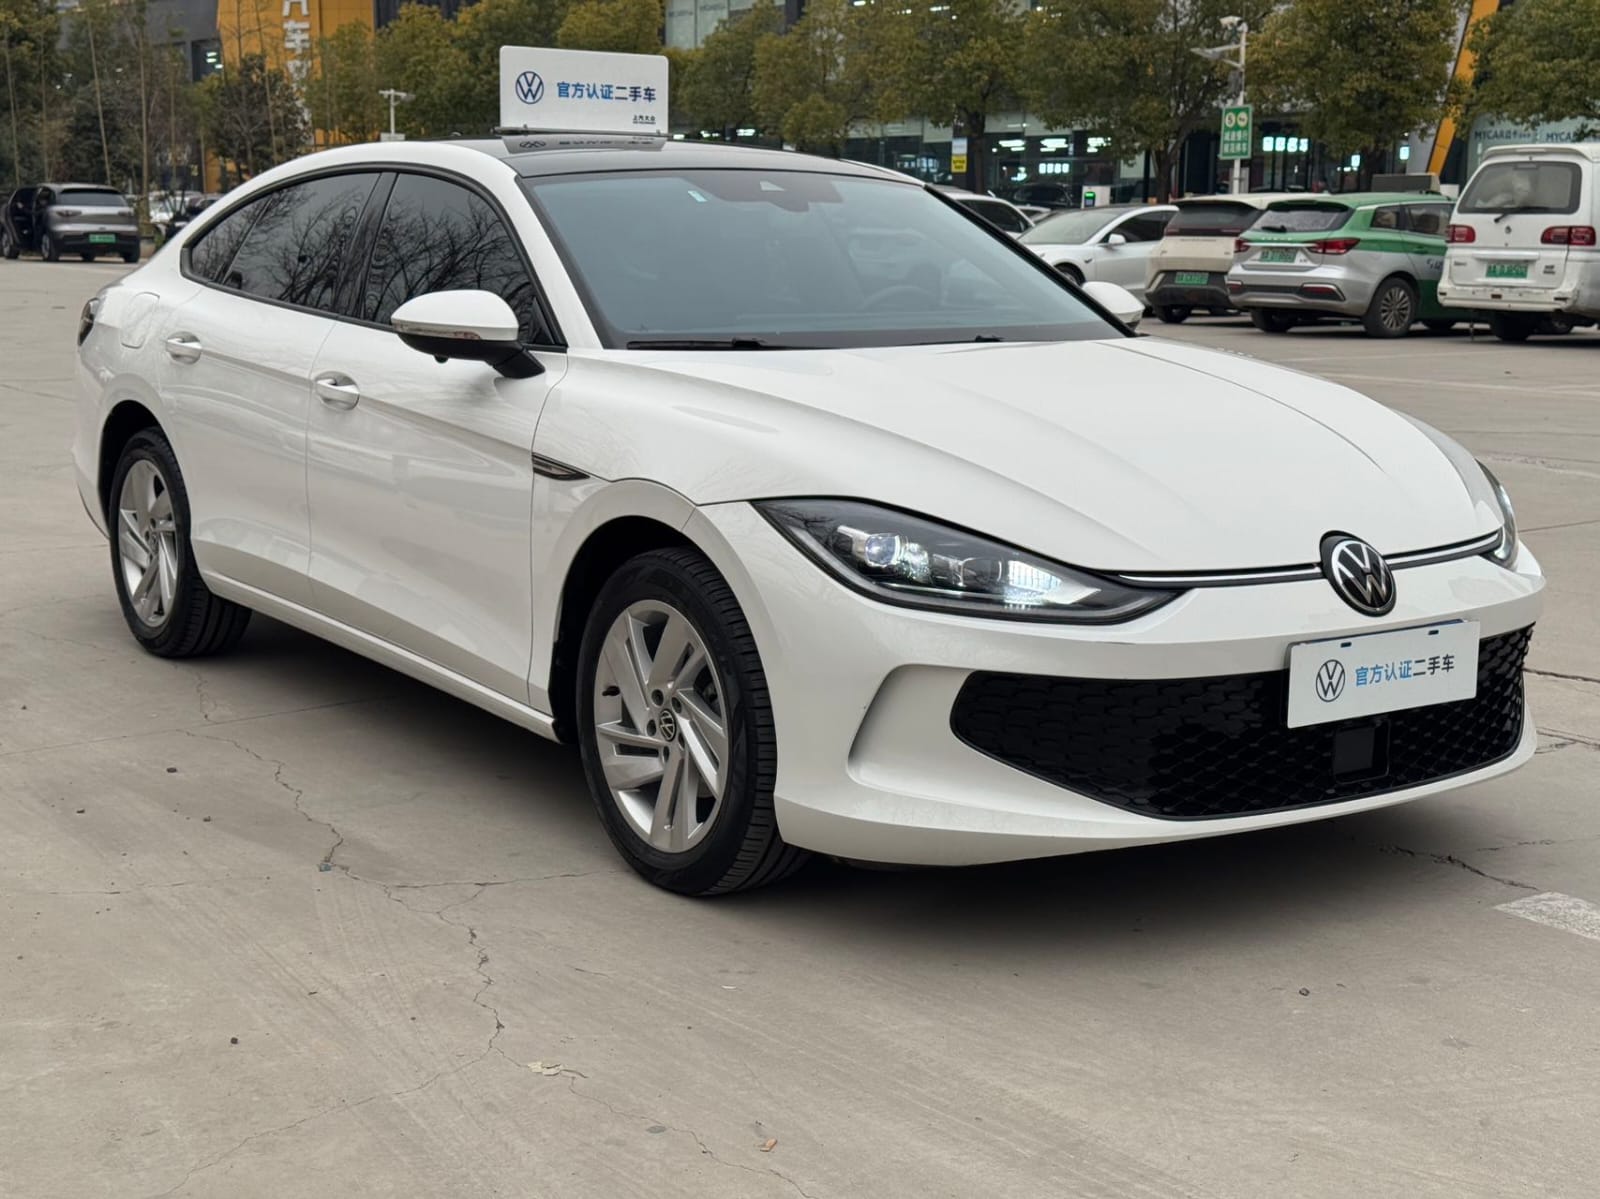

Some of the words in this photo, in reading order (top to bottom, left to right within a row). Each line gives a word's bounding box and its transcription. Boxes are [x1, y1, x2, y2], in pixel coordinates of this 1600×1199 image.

[556, 81, 656, 103] 官方认证二手车
[1355, 653, 1455, 687] 官方认证二手车
